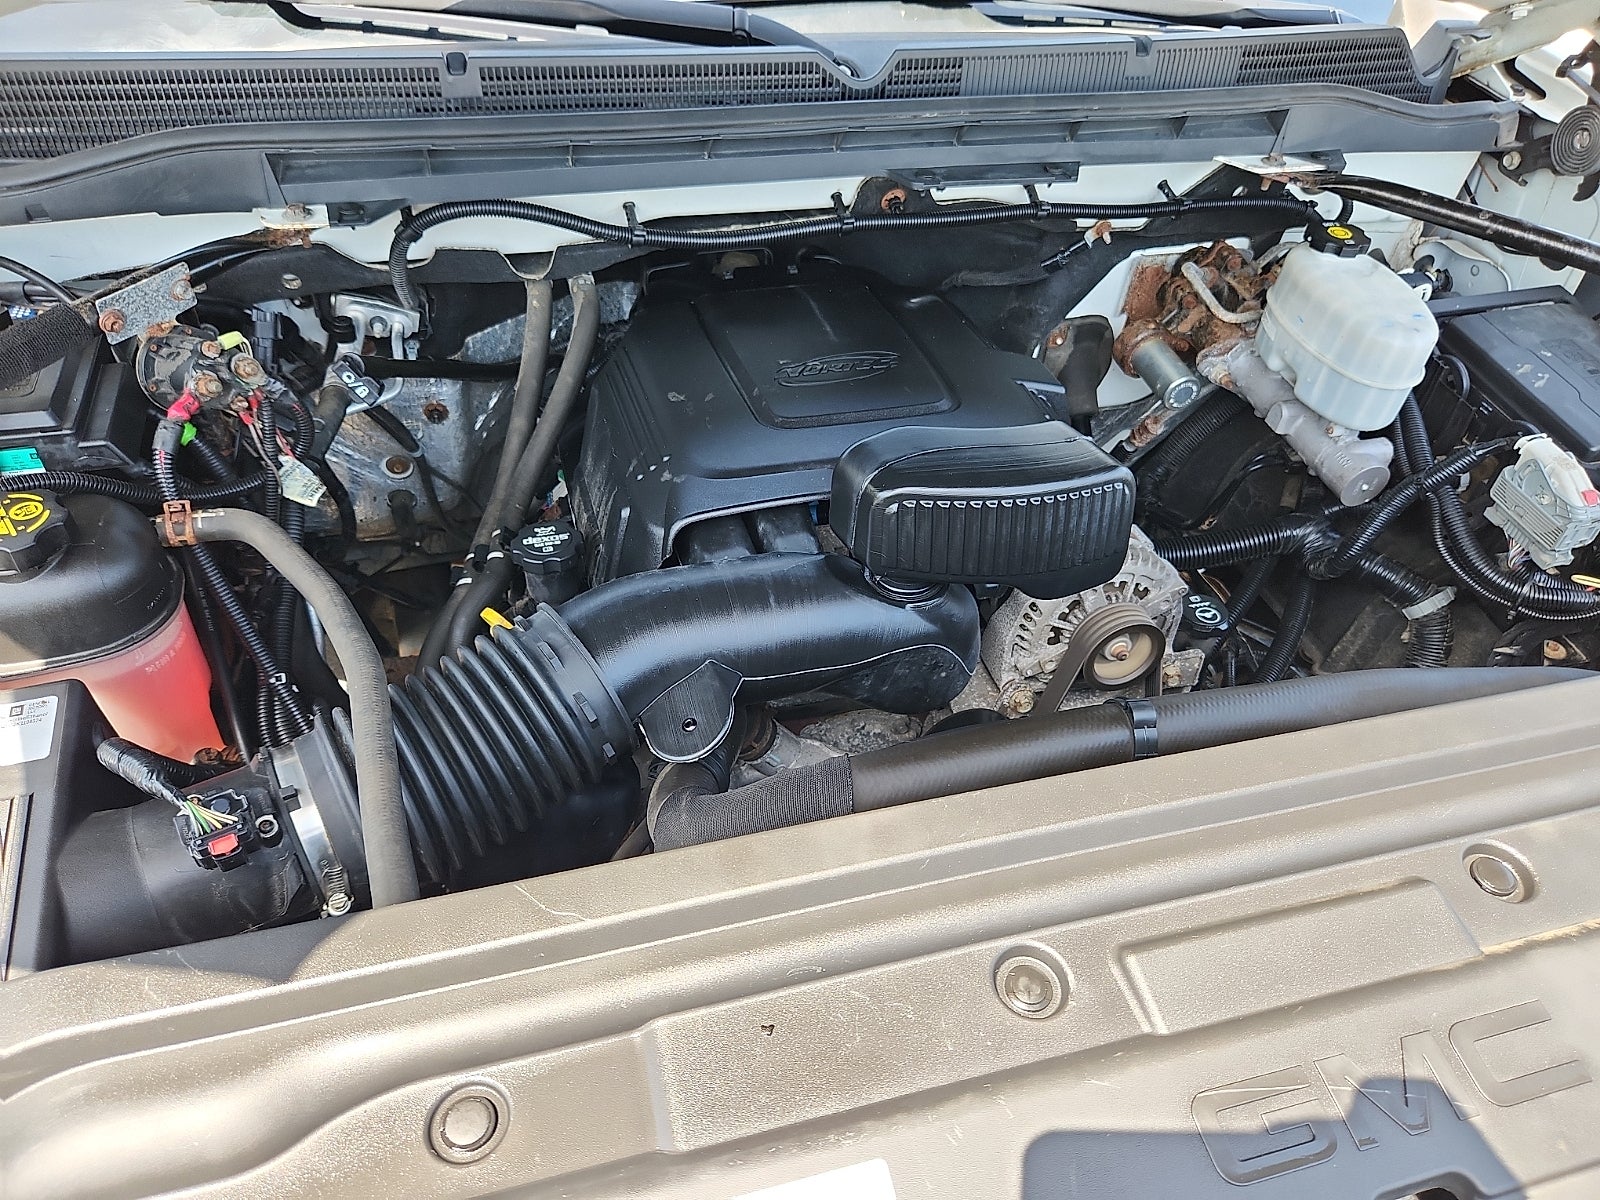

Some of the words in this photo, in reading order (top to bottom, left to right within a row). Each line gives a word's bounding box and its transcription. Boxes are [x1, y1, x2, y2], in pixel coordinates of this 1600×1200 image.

[778, 359, 899, 379] VORTEC
[522, 533, 570, 546] dexos
[1191, 999, 1592, 1187] GMC
